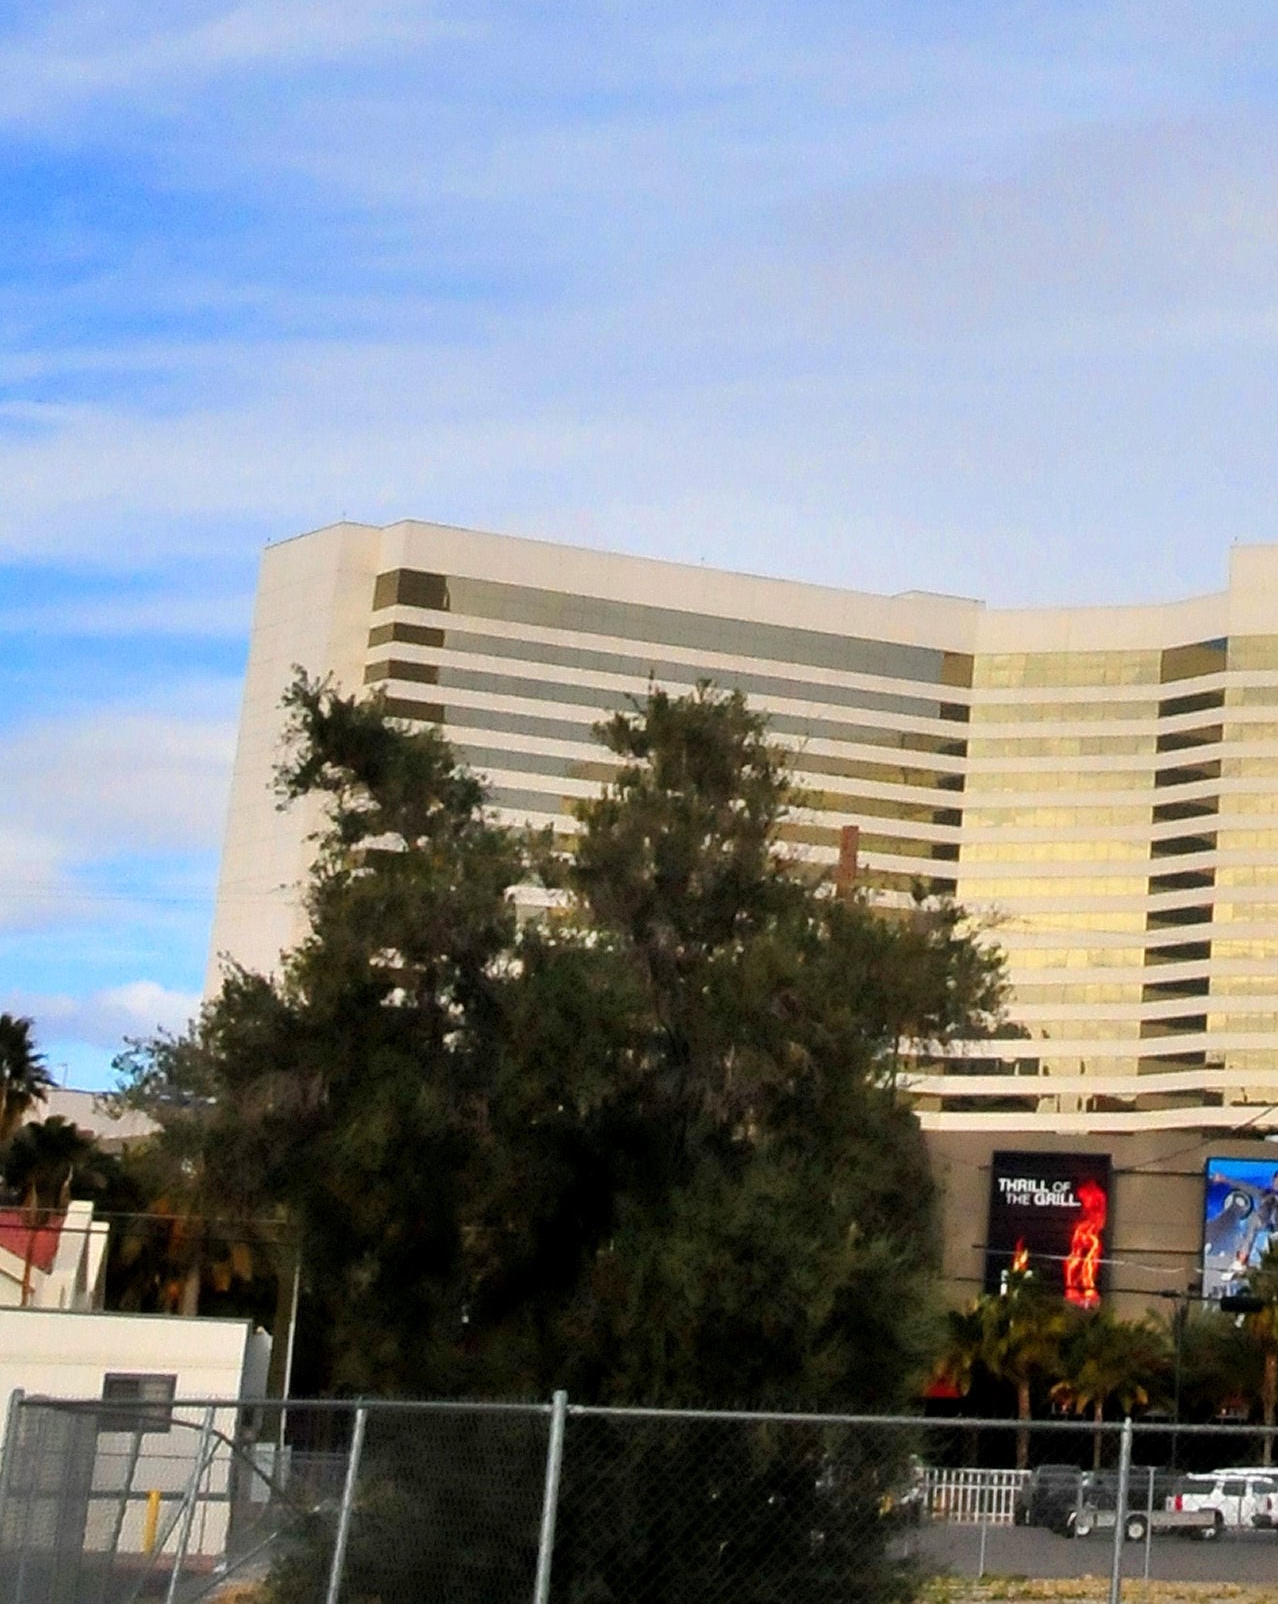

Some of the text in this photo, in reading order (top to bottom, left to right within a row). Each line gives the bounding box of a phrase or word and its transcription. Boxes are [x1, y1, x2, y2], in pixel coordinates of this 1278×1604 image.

[998, 1177, 1071, 1193] THRILL OF
[1006, 1192, 1031, 1205] THE
